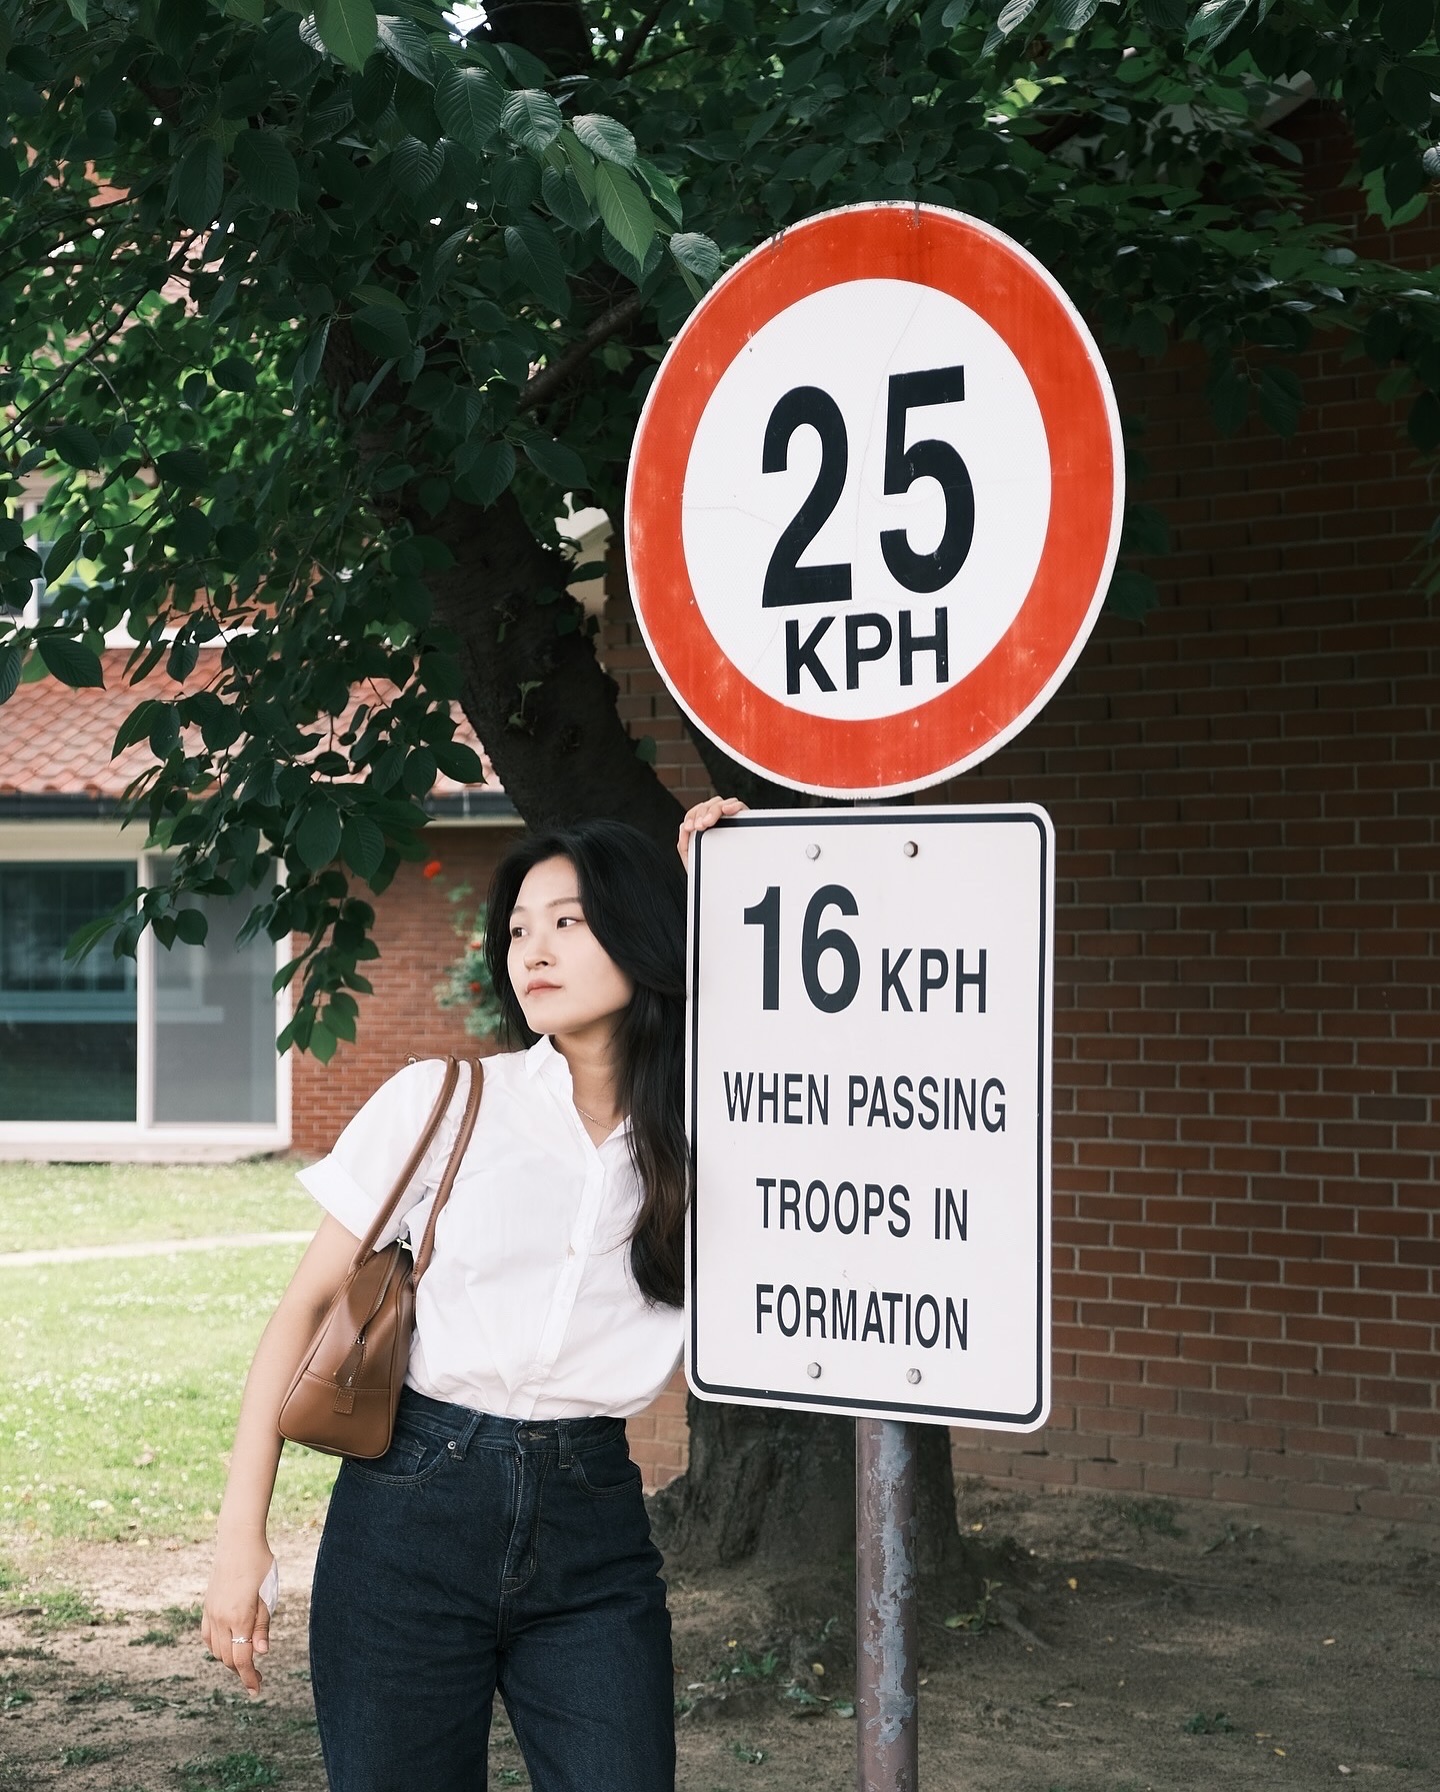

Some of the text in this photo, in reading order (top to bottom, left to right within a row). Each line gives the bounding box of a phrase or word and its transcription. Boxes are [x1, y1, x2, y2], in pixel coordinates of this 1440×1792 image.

[761, 364, 976, 609] 25
[785, 606, 949, 696] KPH
[743, 884, 987, 1014] 16 KPH
[723, 1071, 1006, 1133] WHEN PASSING
[756, 1177, 968, 1242] TROOPS IN
[755, 1283, 968, 1351] FORMATION
